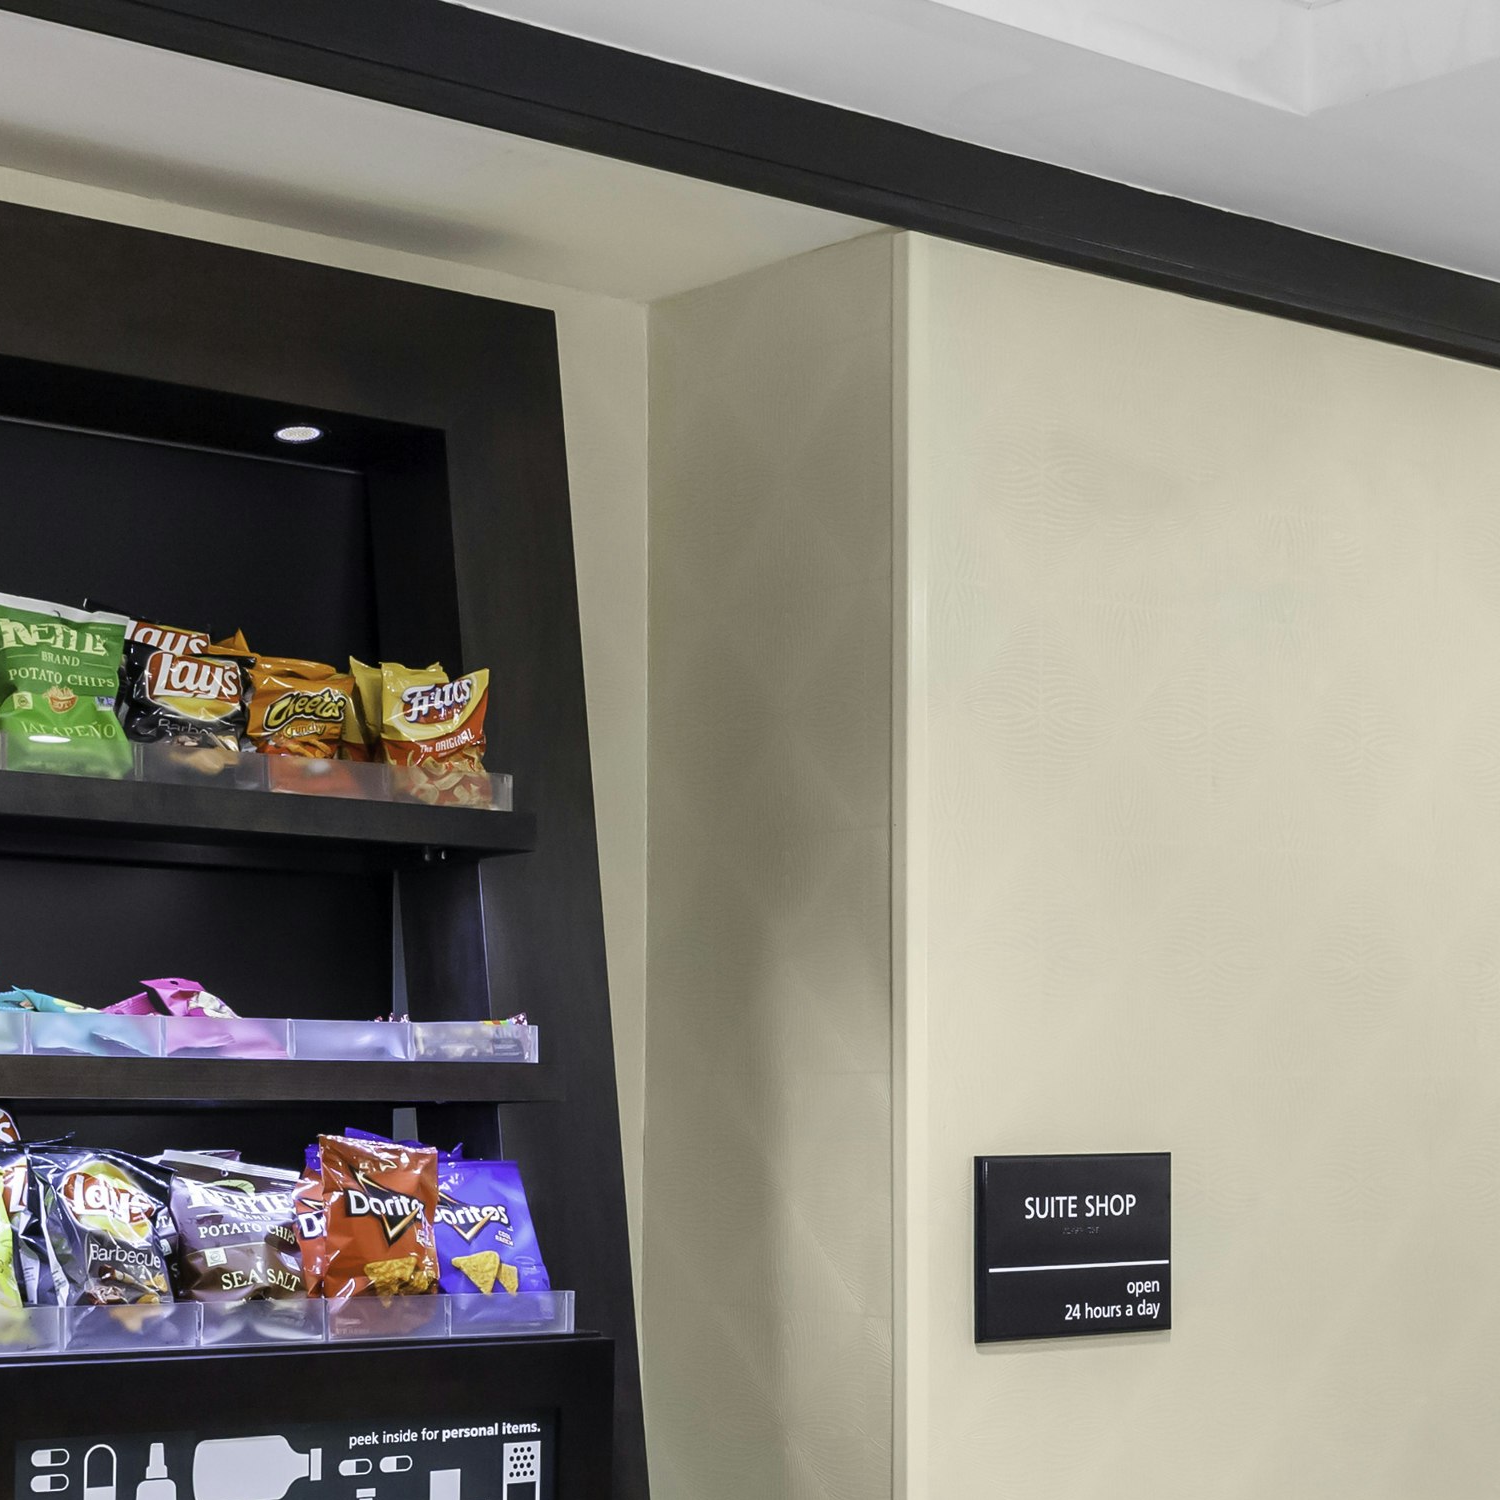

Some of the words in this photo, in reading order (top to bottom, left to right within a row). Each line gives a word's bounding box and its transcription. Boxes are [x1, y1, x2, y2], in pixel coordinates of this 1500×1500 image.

[41, 651, 80, 667] BRAND
[8, 667, 63, 685] POTATO
[66, 674, 115, 689] CHIPS
[151, 655, 238, 700] Lay's
[265, 690, 346, 731] Cheetos
[401, 678, 472, 724] Fritos
[435, 728, 475, 753] ORIGINAL
[67, 1175, 154, 1223] Lay's
[1025, 1196, 1078, 1219] SUITE
[1085, 1194, 1136, 1217] SHOP
[199, 1222, 261, 1239] POTATO
[267, 1224, 296, 1244] CHIPS
[90, 1243, 161, 1268] Barbecue
[222, 1268, 263, 1291] SEA
[267, 1268, 300, 1292] SALT
[1127, 1280, 1160, 1297] open
[1064, 1304, 1081, 1320] 24
[1085, 1302, 1121, 1319] hours
[1125, 1305, 1133, 1316] a
[1137, 1299, 1160, 1319] day
[349, 1431, 379, 1449] peek
[382, 1429, 418, 1444] inside
[421, 1427, 439, 1441] for
[442, 1422, 498, 1442] personal
[502, 1421, 541, 1435] items.
